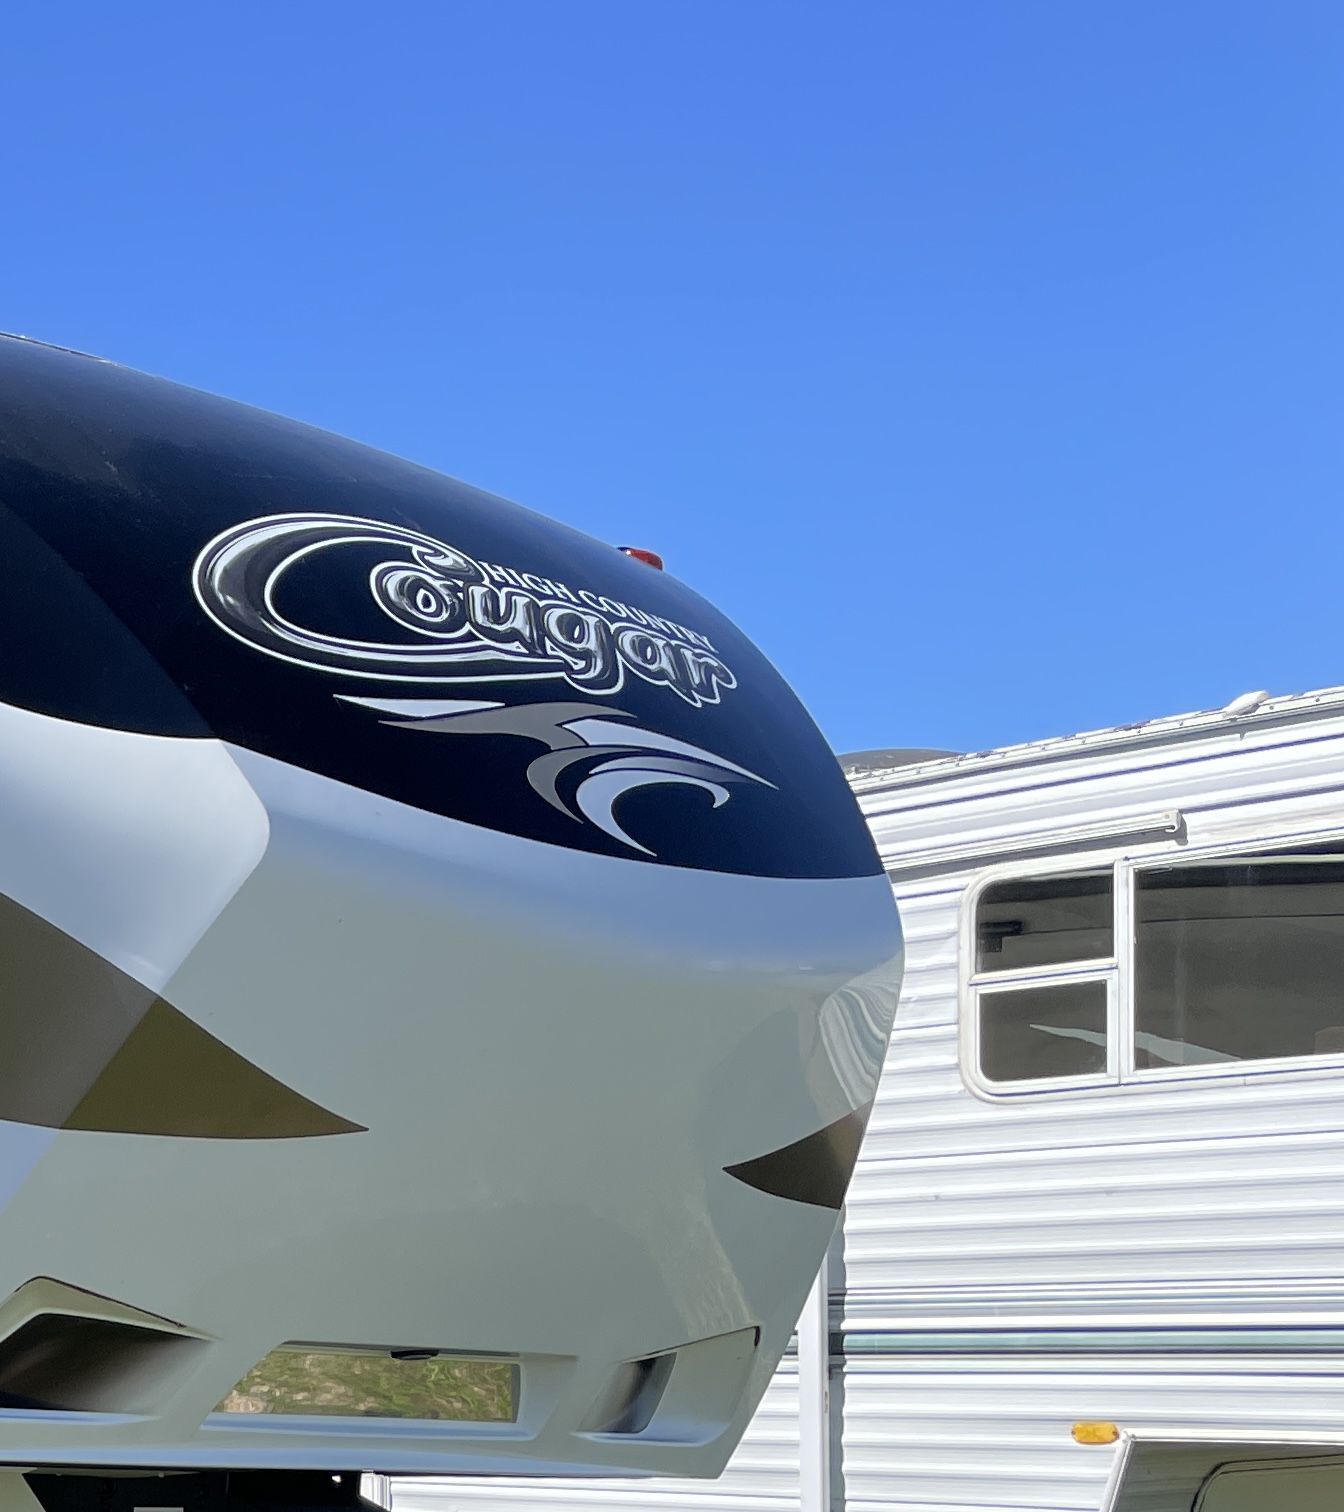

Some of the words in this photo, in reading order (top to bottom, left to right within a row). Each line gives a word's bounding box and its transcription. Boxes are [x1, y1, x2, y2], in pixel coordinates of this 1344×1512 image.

[192, 512, 738, 708] Cougar
[486, 562, 581, 604] HIGH
[578, 590, 719, 654] COUNTRY
